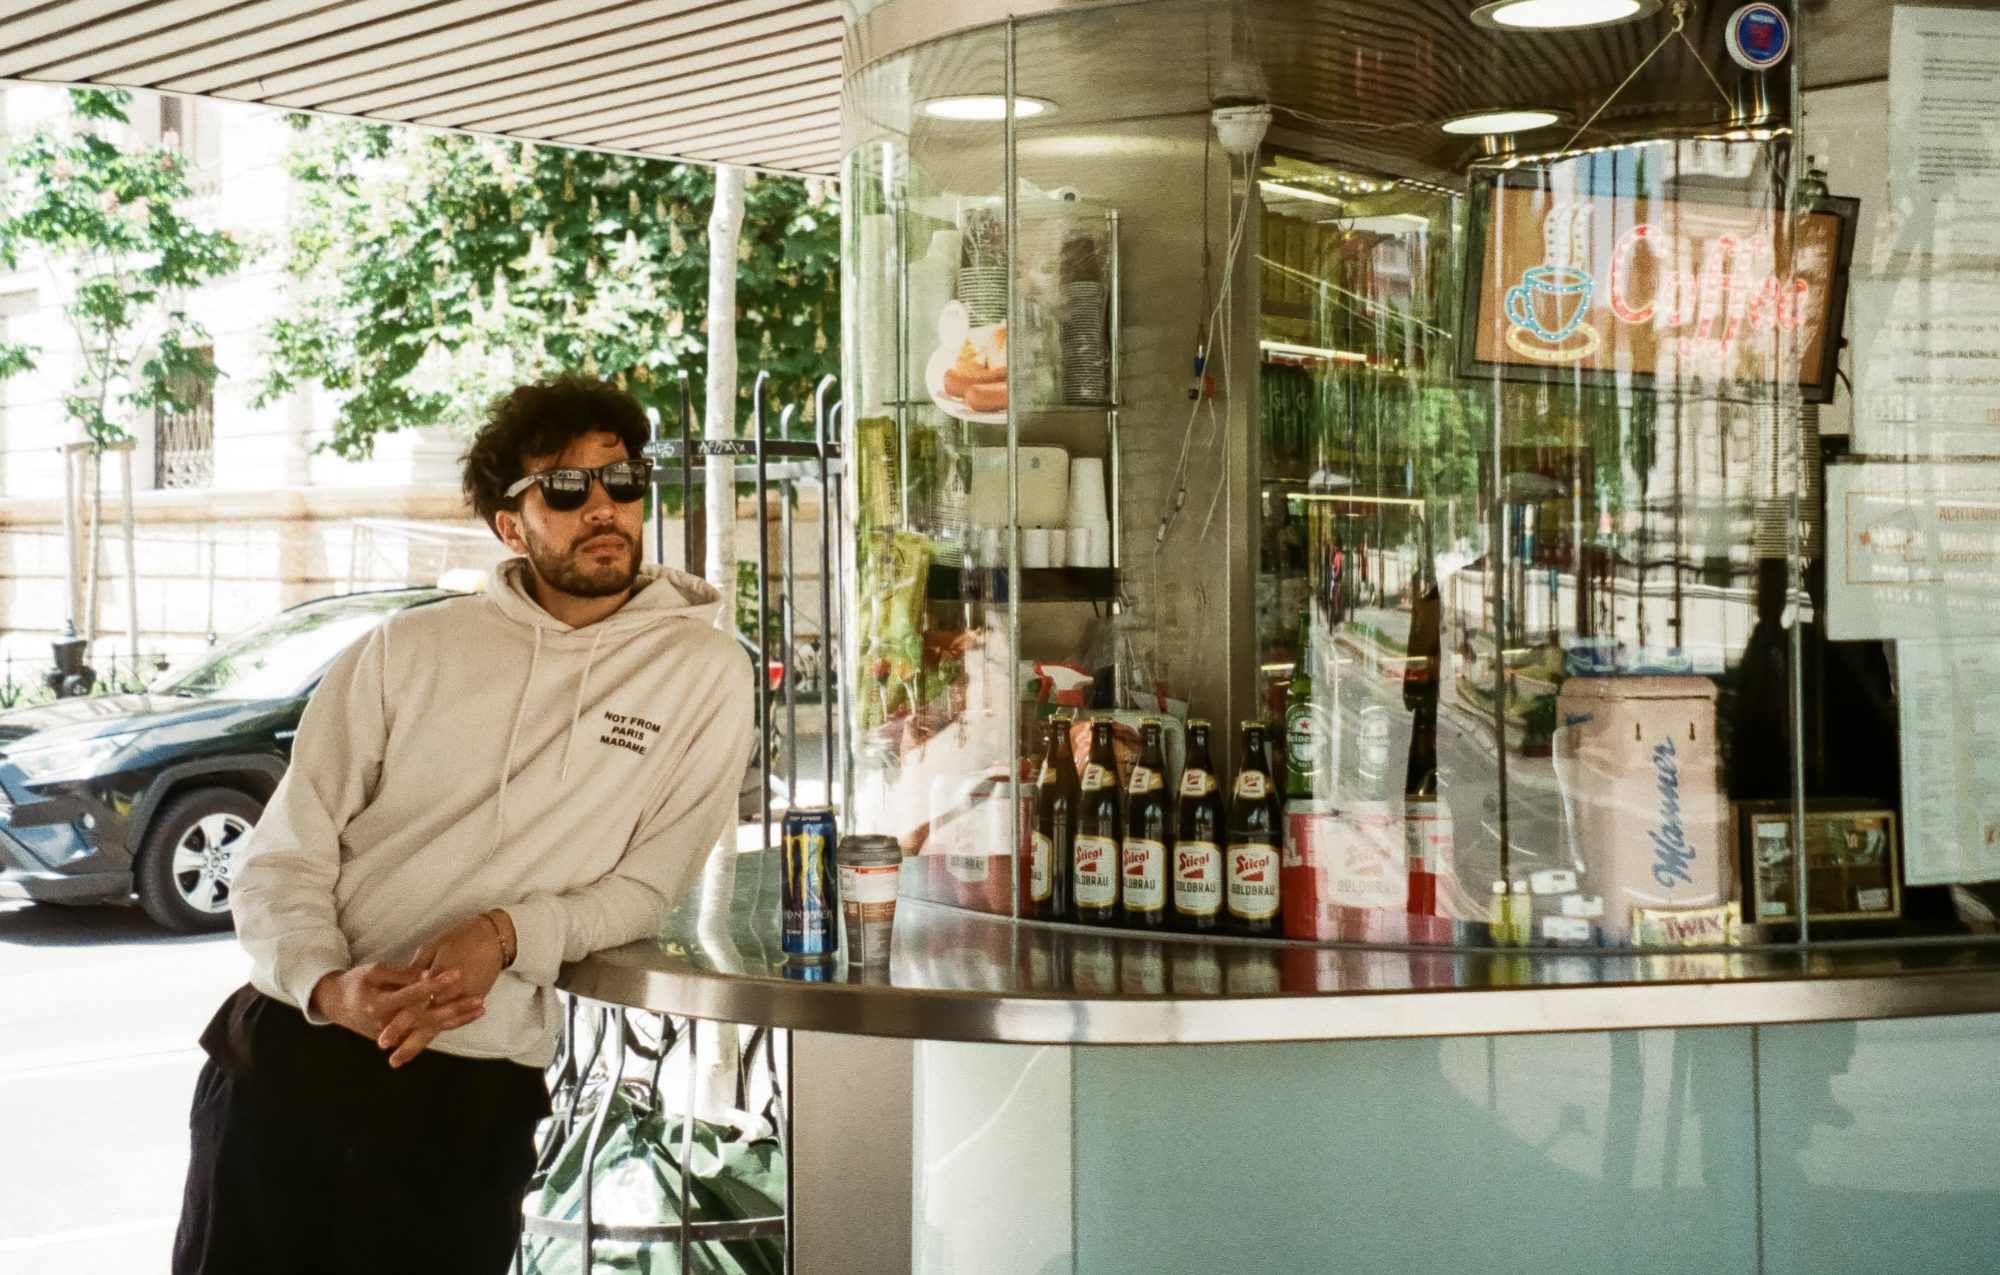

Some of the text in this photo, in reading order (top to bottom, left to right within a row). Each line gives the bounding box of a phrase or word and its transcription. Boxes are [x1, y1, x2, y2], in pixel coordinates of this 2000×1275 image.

[1608, 224, 1809, 360] Coffee
[604, 711, 661, 733] NOT FROM
[611, 726, 645, 741] PARIS
[600, 735, 647, 755] MADAME
[1648, 736, 1697, 888] Manner
[1076, 845, 1103, 864] Stiegl
[1123, 847, 1150, 865] Stiegl
[1179, 851, 1210, 871] Stiegl
[1236, 854, 1270, 875] Stiegl
